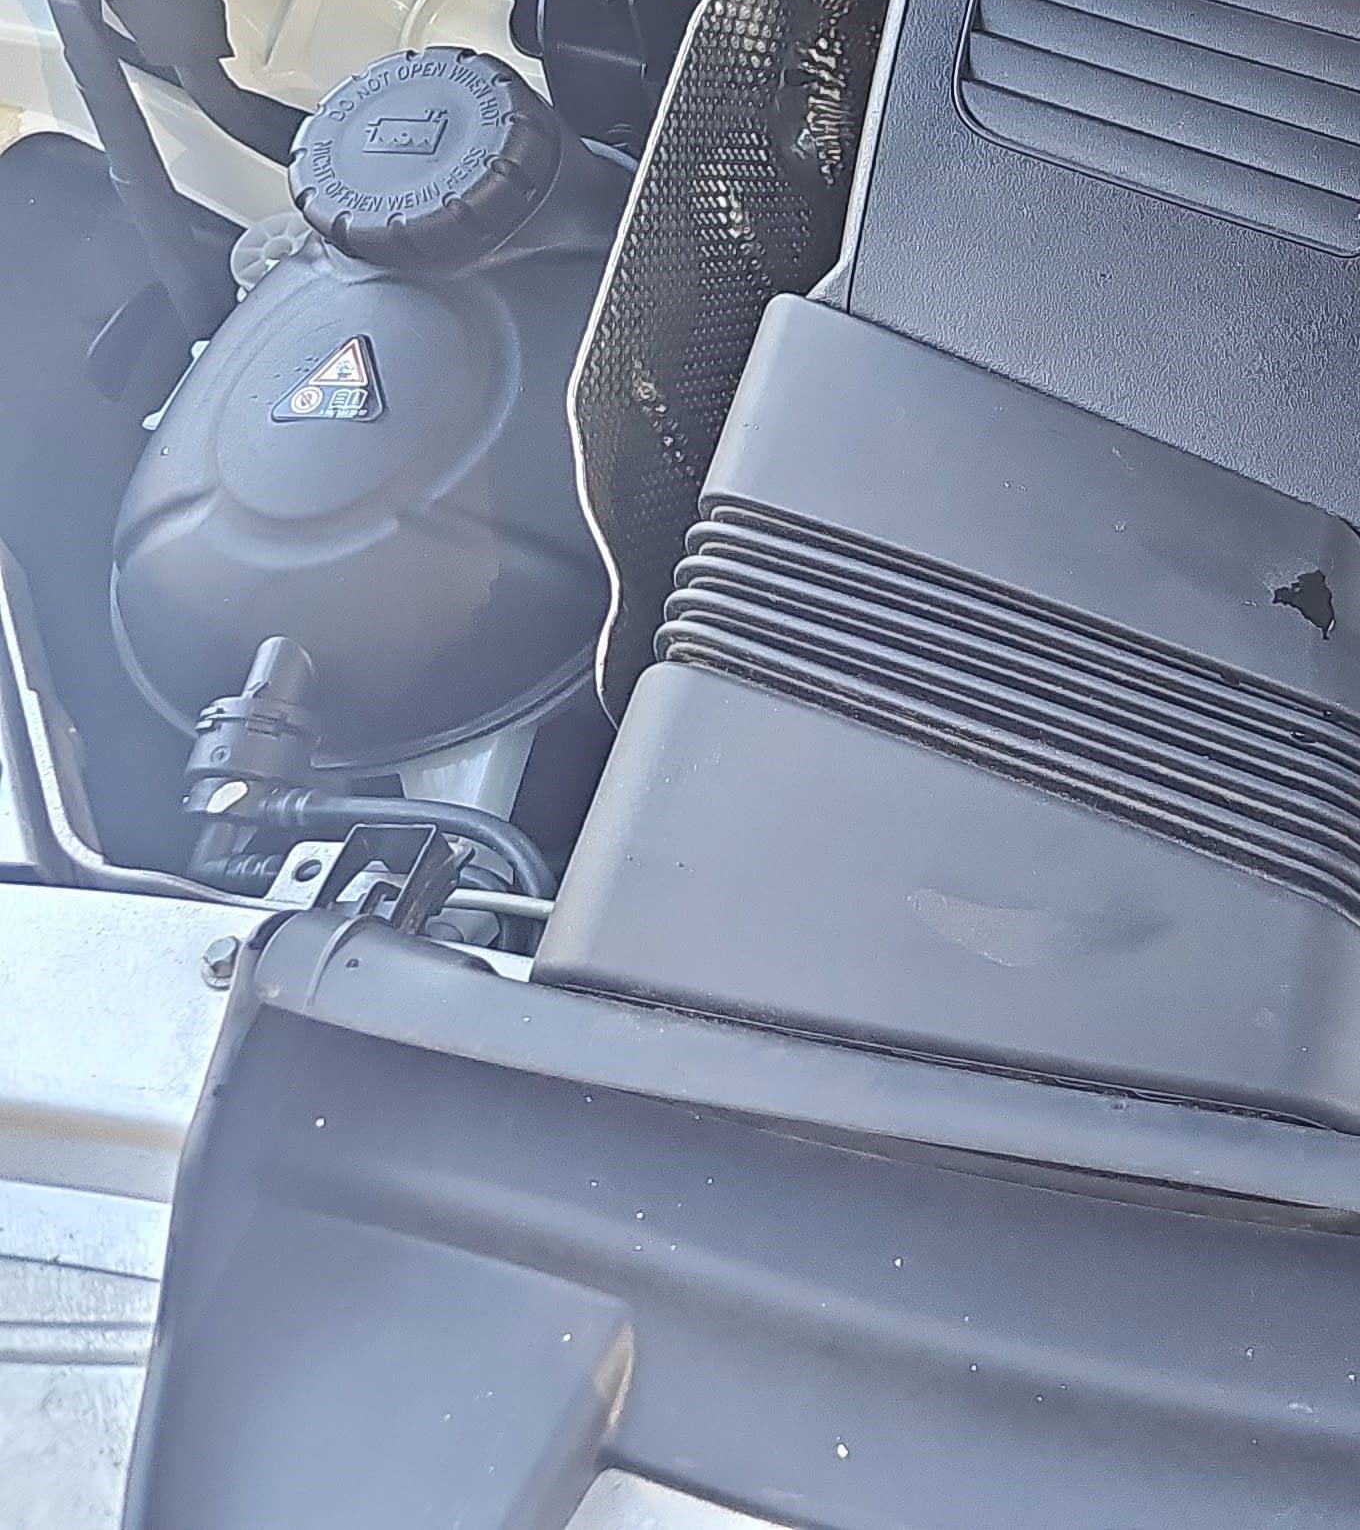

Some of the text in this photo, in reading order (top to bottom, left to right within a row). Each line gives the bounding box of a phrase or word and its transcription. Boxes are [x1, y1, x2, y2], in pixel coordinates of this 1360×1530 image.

[328, 61, 502, 128] DO NOT OPEN WHEN HOT
[312, 140, 336, 183] NICHT
[388, 181, 441, 210] WENN
